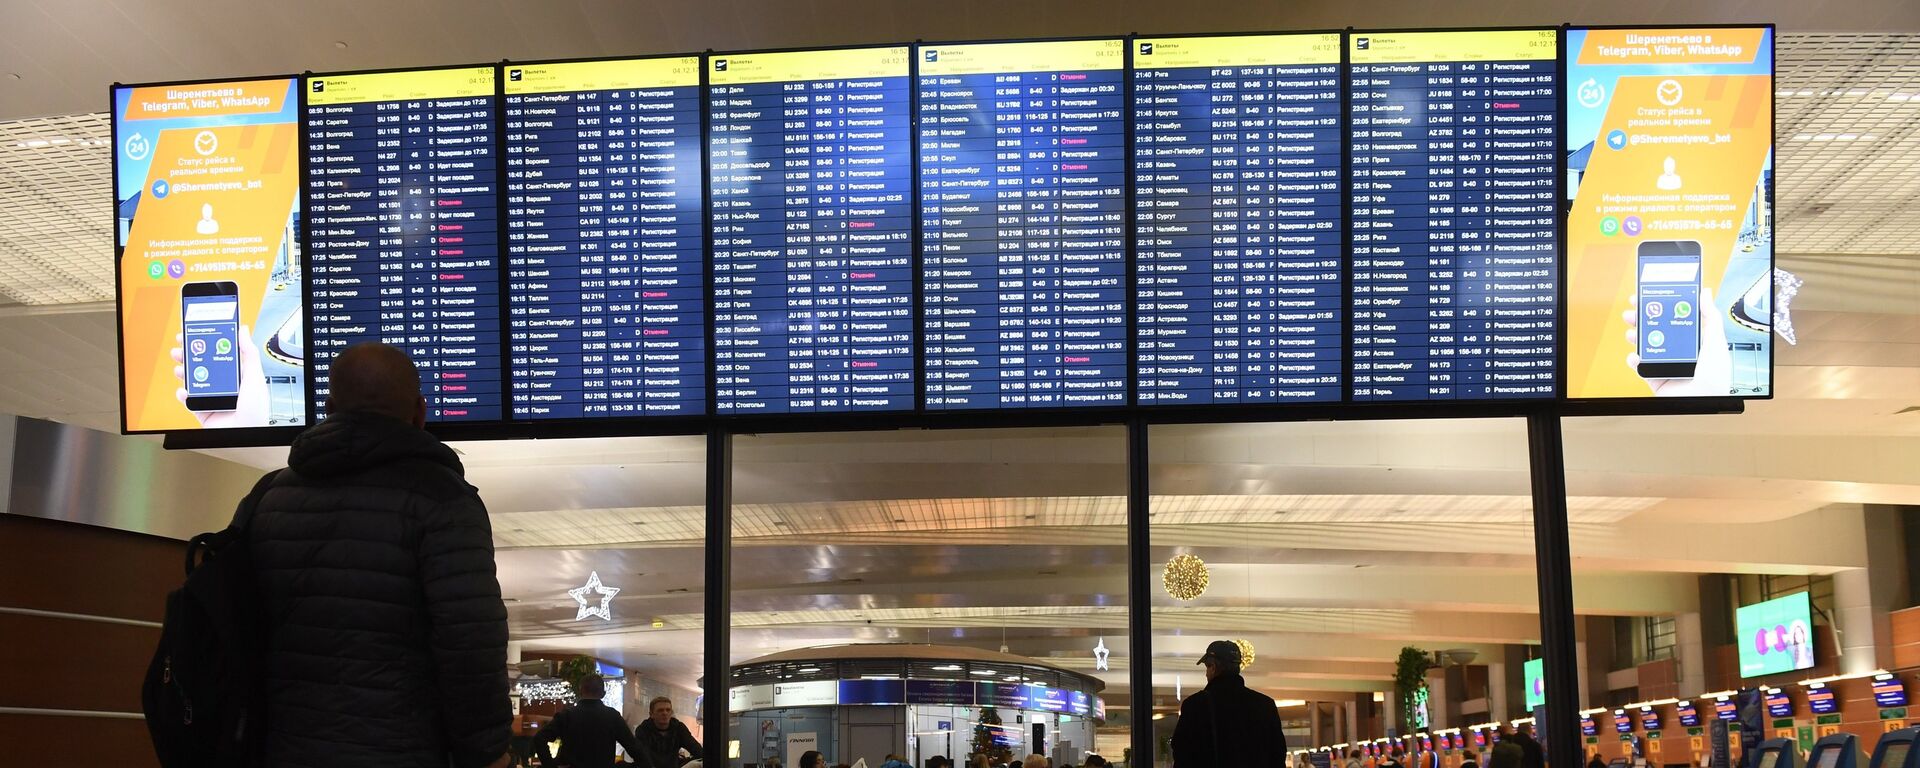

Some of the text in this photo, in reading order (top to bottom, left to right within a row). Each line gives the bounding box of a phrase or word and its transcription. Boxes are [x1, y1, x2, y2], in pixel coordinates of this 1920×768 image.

[1626, 34, 1711, 44] Шереметьево в
[1598, 45, 1742, 57] Telegram, Viber, WhatsApp
[167, 89, 233, 99] Шереметьево
[1584, 89, 1598, 99] 24
[142, 96, 269, 112] Telegram, Viber, WhatsApp
[1637, 107, 1665, 117] Статус
[1668, 107, 1694, 117] рейса
[1372, 117, 1411, 125] Екатеринбург
[1628, 118, 1711, 128] реальном времени
[131, 143, 144, 152] 24
[178, 158, 202, 166] Статус
[205, 157, 228, 165] рейса
[170, 166, 243, 176] реальном времени
[1602, 193, 1730, 203] Информационная поддержка
[1640, 205, 1675, 213] диалога
[1685, 204, 1736, 213] оператором
[731, 212, 759, 220] Нью-Йорк
[149, 237, 262, 248] Информационная поддержка
[182, 248, 213, 256] диалога
[222, 246, 268, 254] оператором
